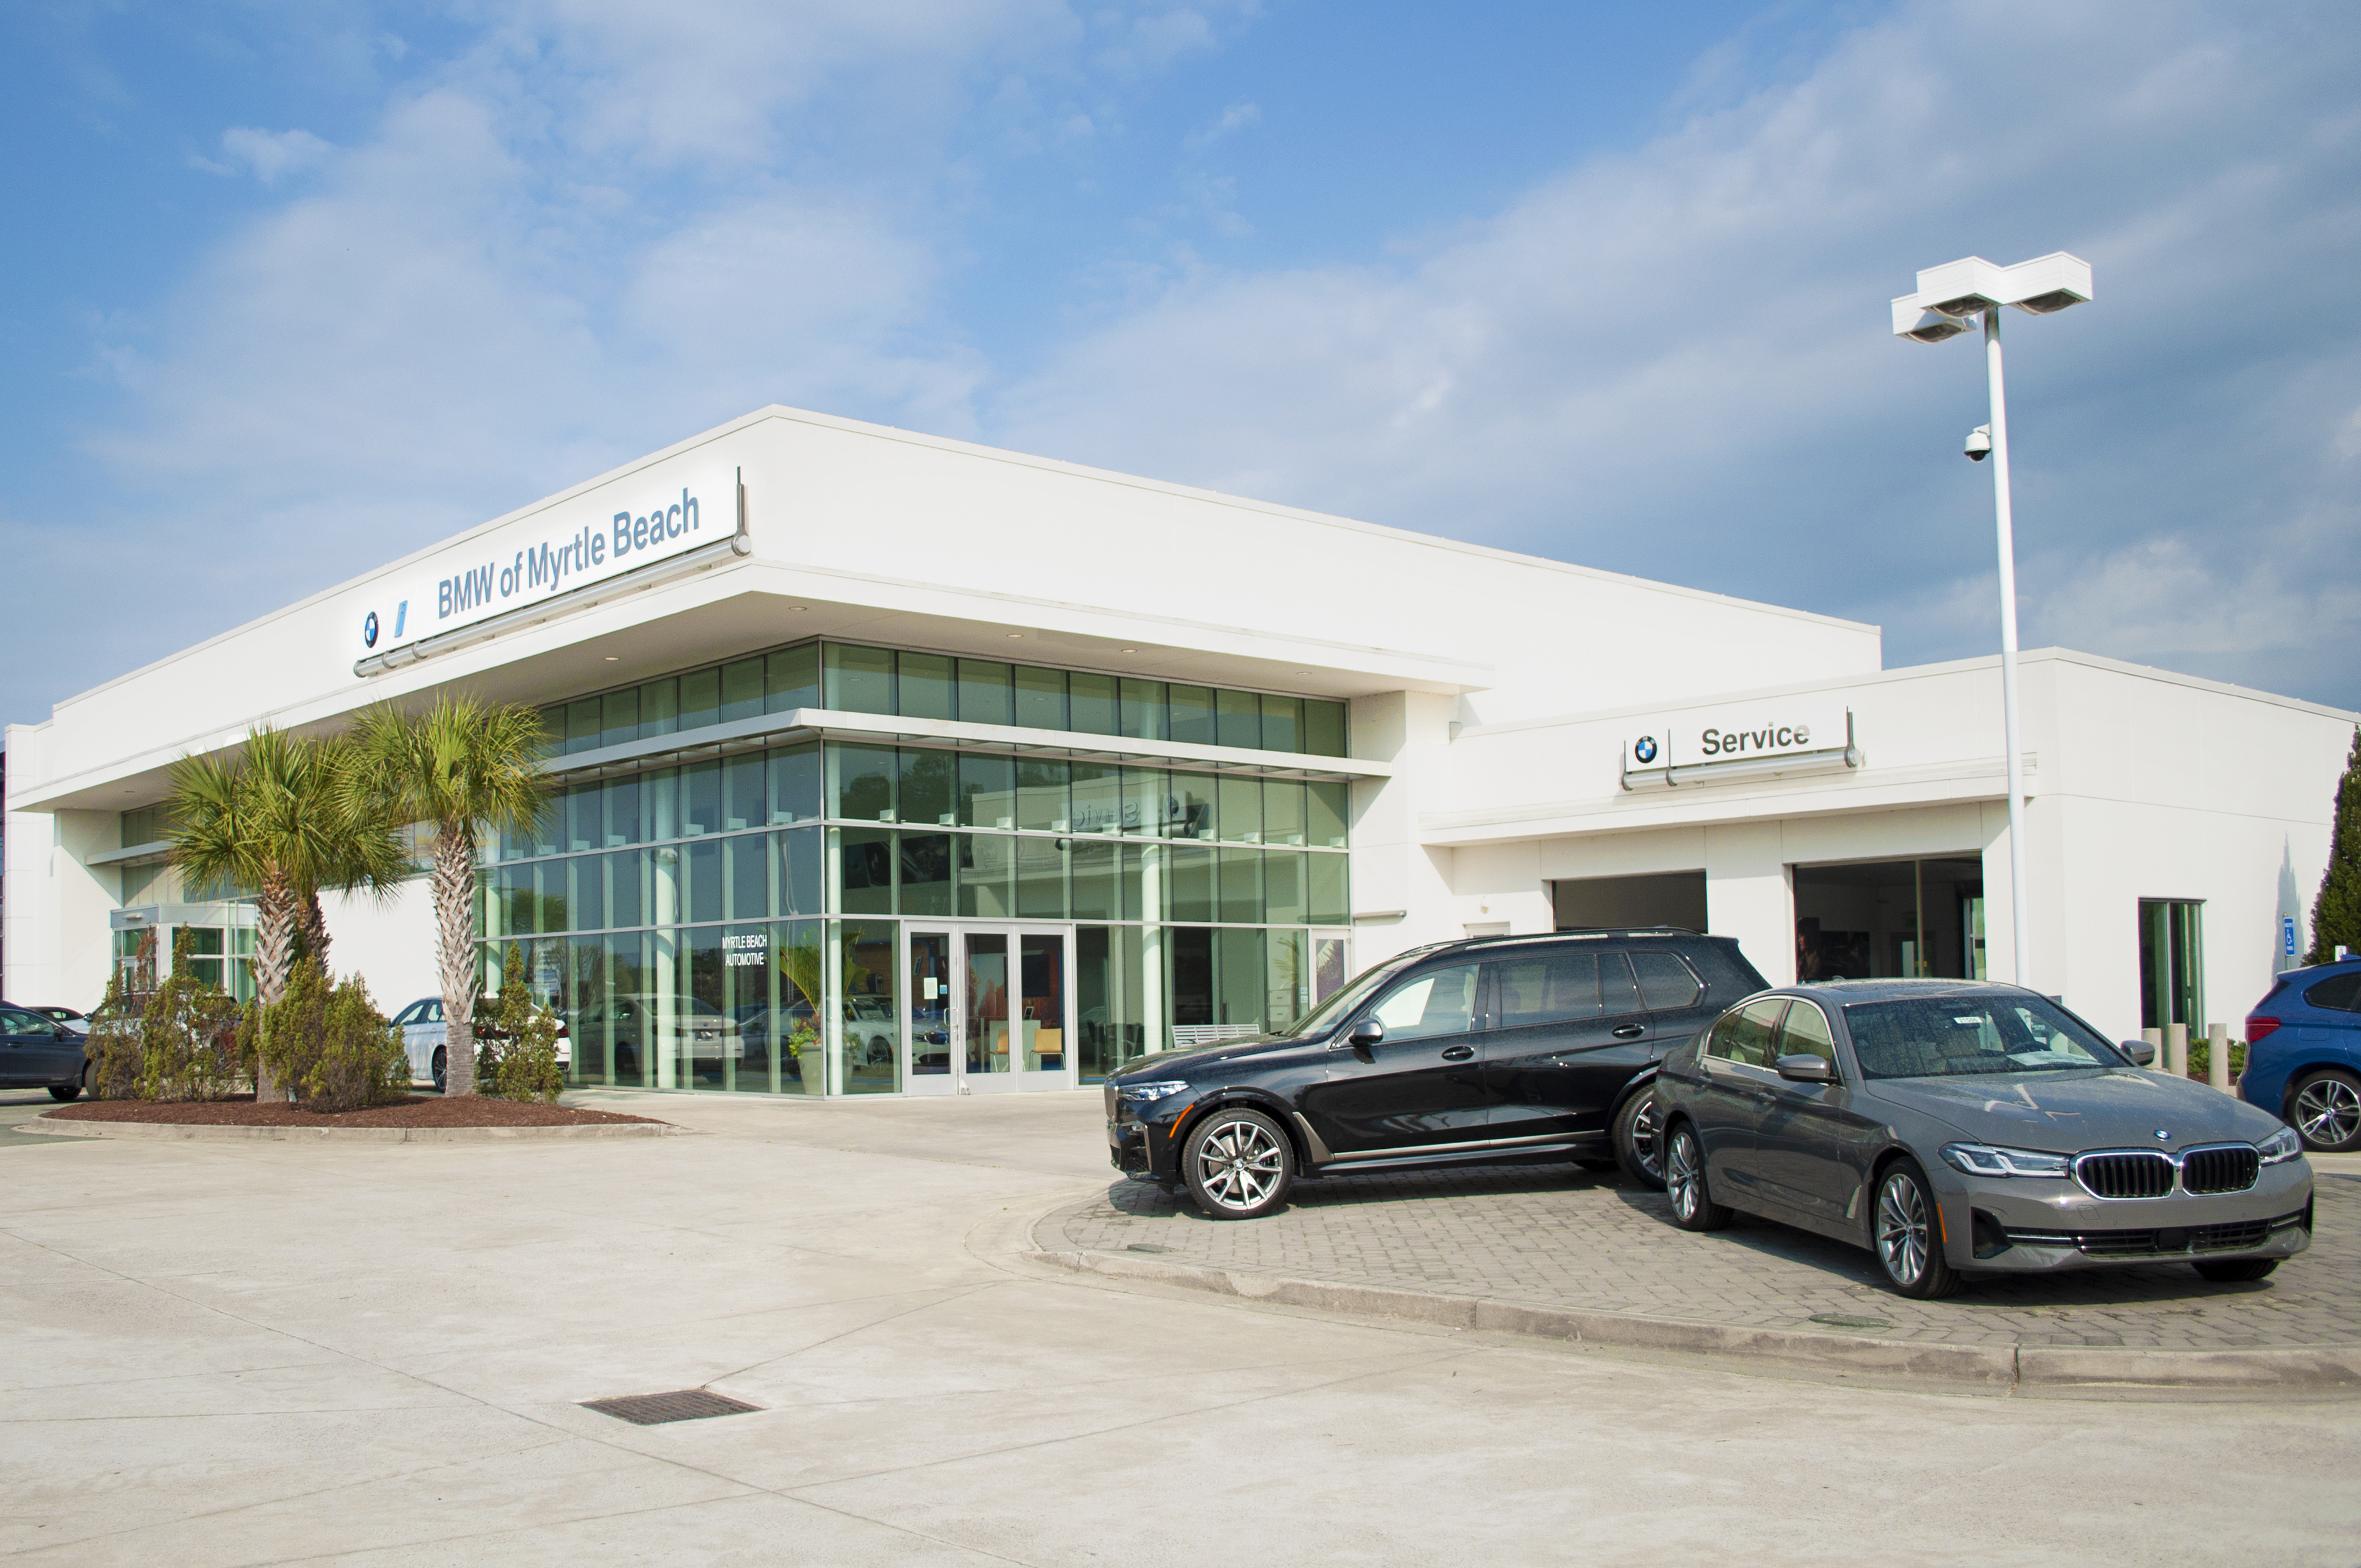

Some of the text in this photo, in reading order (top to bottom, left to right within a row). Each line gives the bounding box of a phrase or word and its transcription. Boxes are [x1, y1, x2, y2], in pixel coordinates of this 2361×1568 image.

[439, 487, 699, 620] BMW of Myrtle Beach
[1702, 721, 1810, 755] Service
[722, 935, 767, 949] MYRTLE BEACH
[725, 952, 764, 966] AUTOMOTIVE
